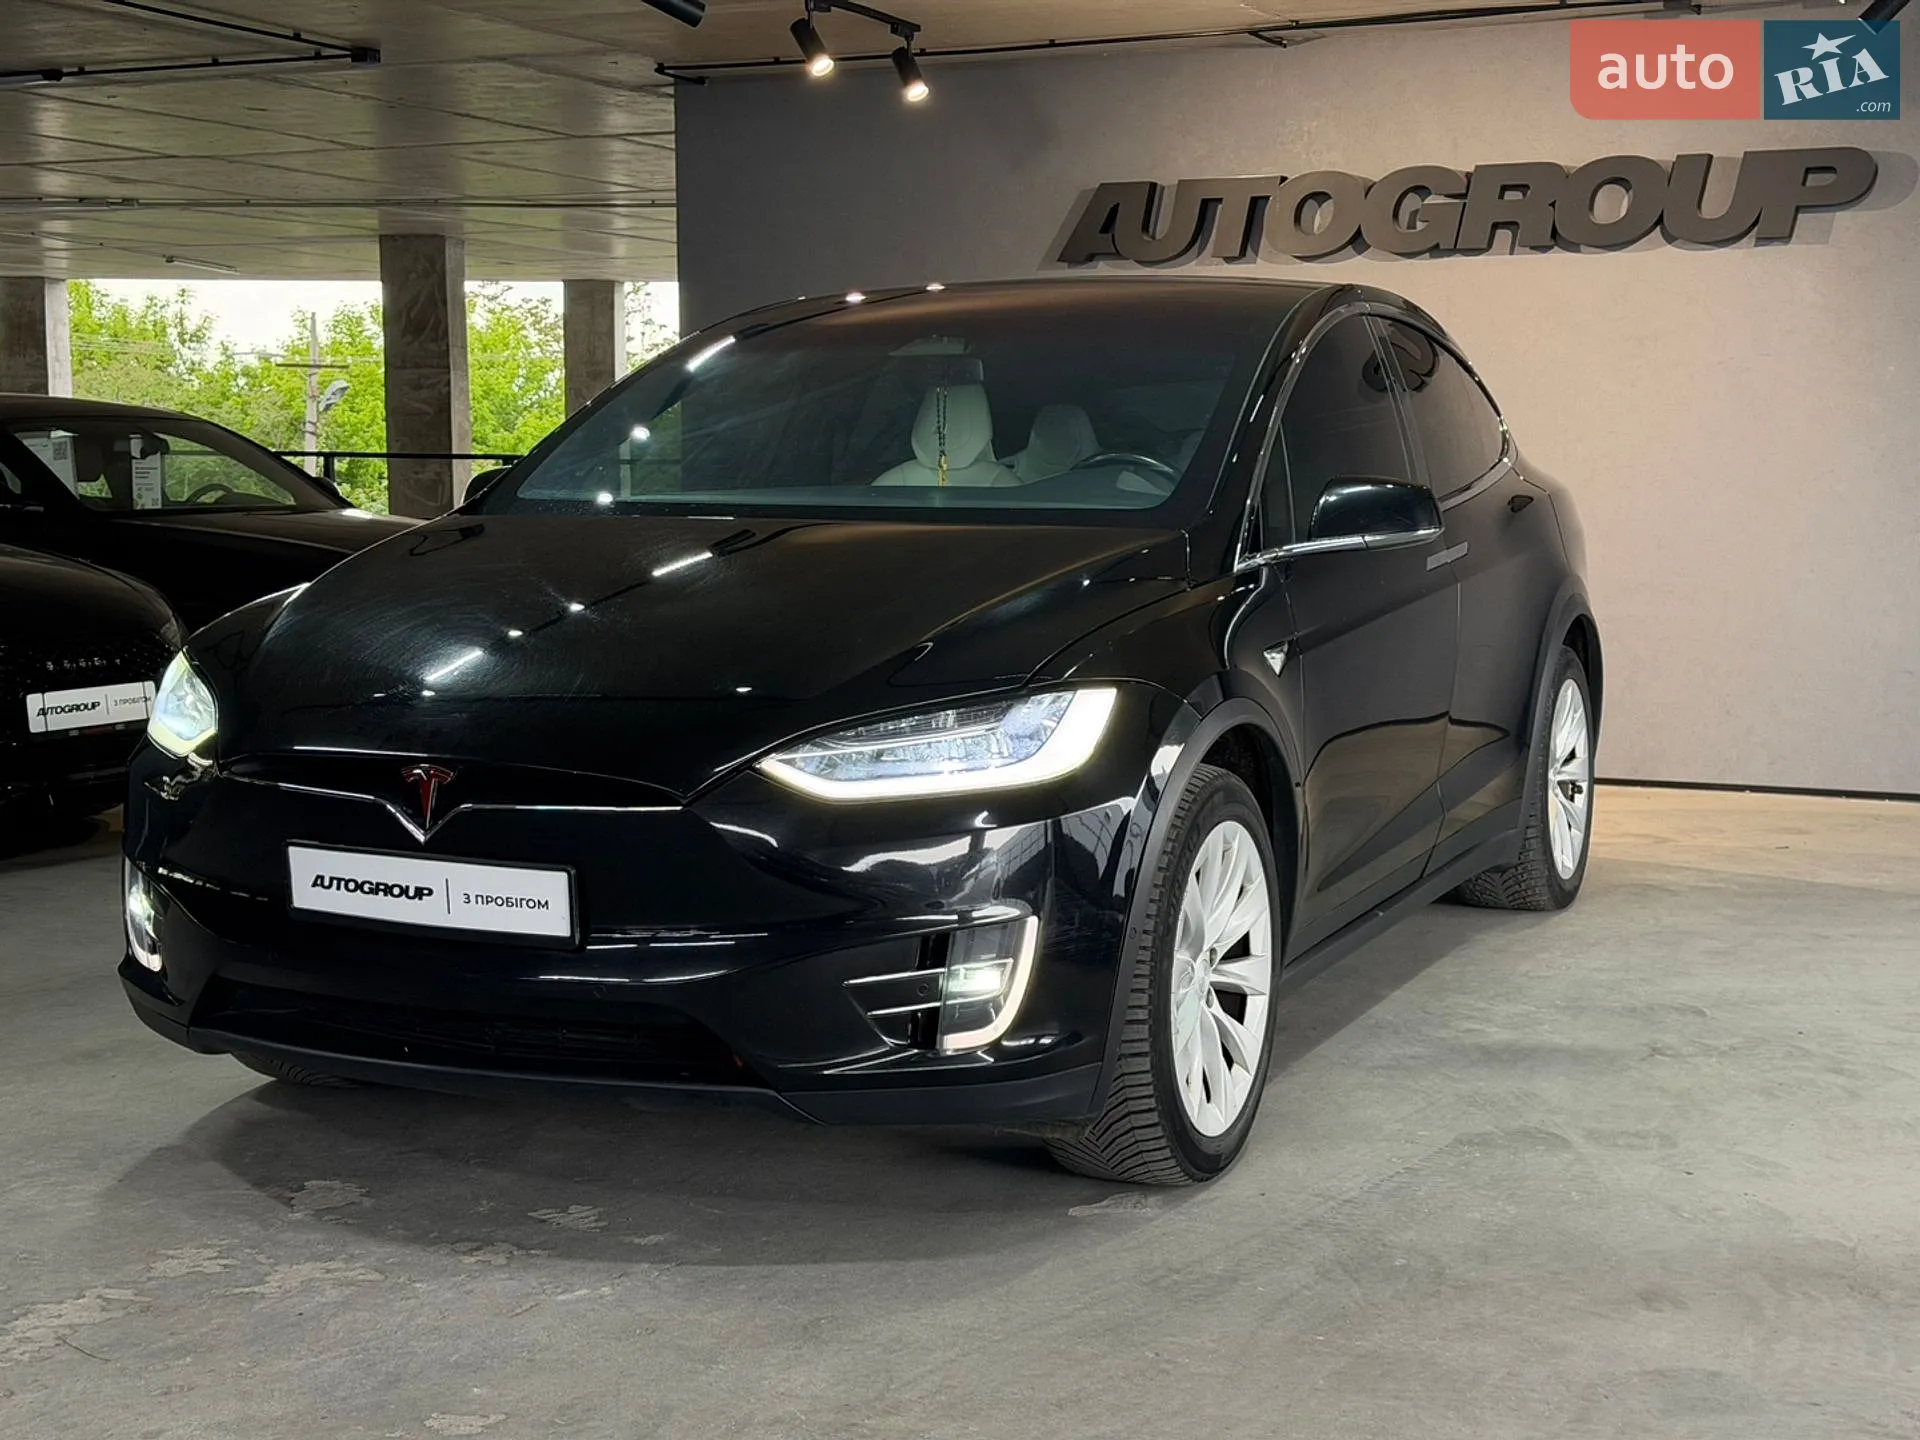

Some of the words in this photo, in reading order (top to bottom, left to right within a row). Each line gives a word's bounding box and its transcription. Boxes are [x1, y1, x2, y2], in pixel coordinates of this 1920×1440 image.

[1058, 147, 1879, 265] AUTOGROUP
[36, 701, 101, 718] AUTOGROUP
[311, 873, 434, 901] AUTOGROUP
[475, 894, 550, 910] ПРОБІГОМ
